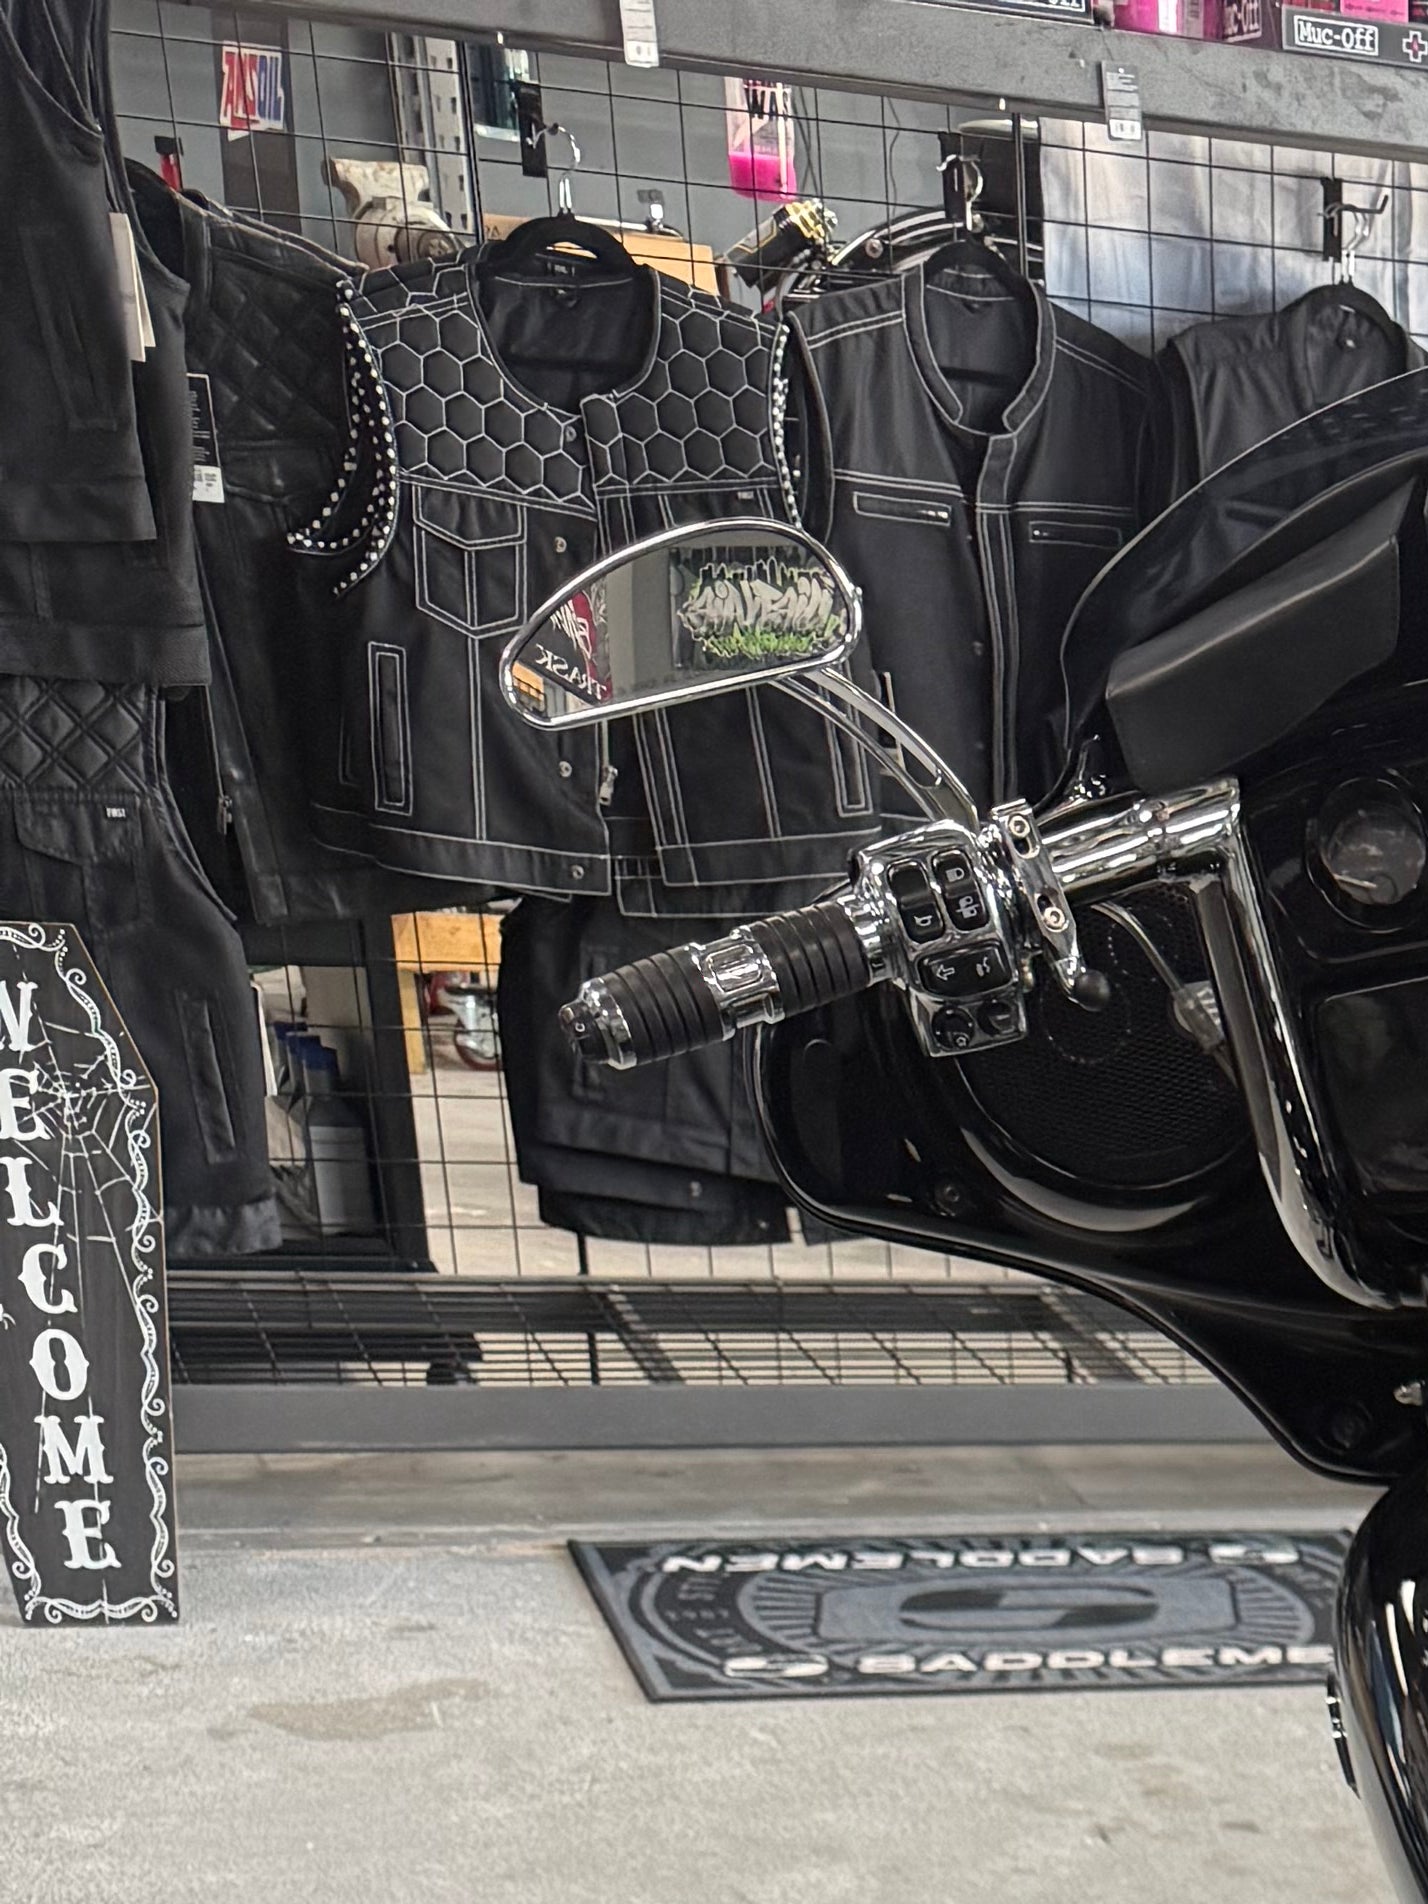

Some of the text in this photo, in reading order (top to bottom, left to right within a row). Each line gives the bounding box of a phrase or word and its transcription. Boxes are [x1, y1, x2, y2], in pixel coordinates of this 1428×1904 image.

[1298, 20, 1376, 52] Muc-Off
[661, 1547, 1185, 1573] SADDLEMEN
[856, 1647, 1335, 1675] SADDLEME
